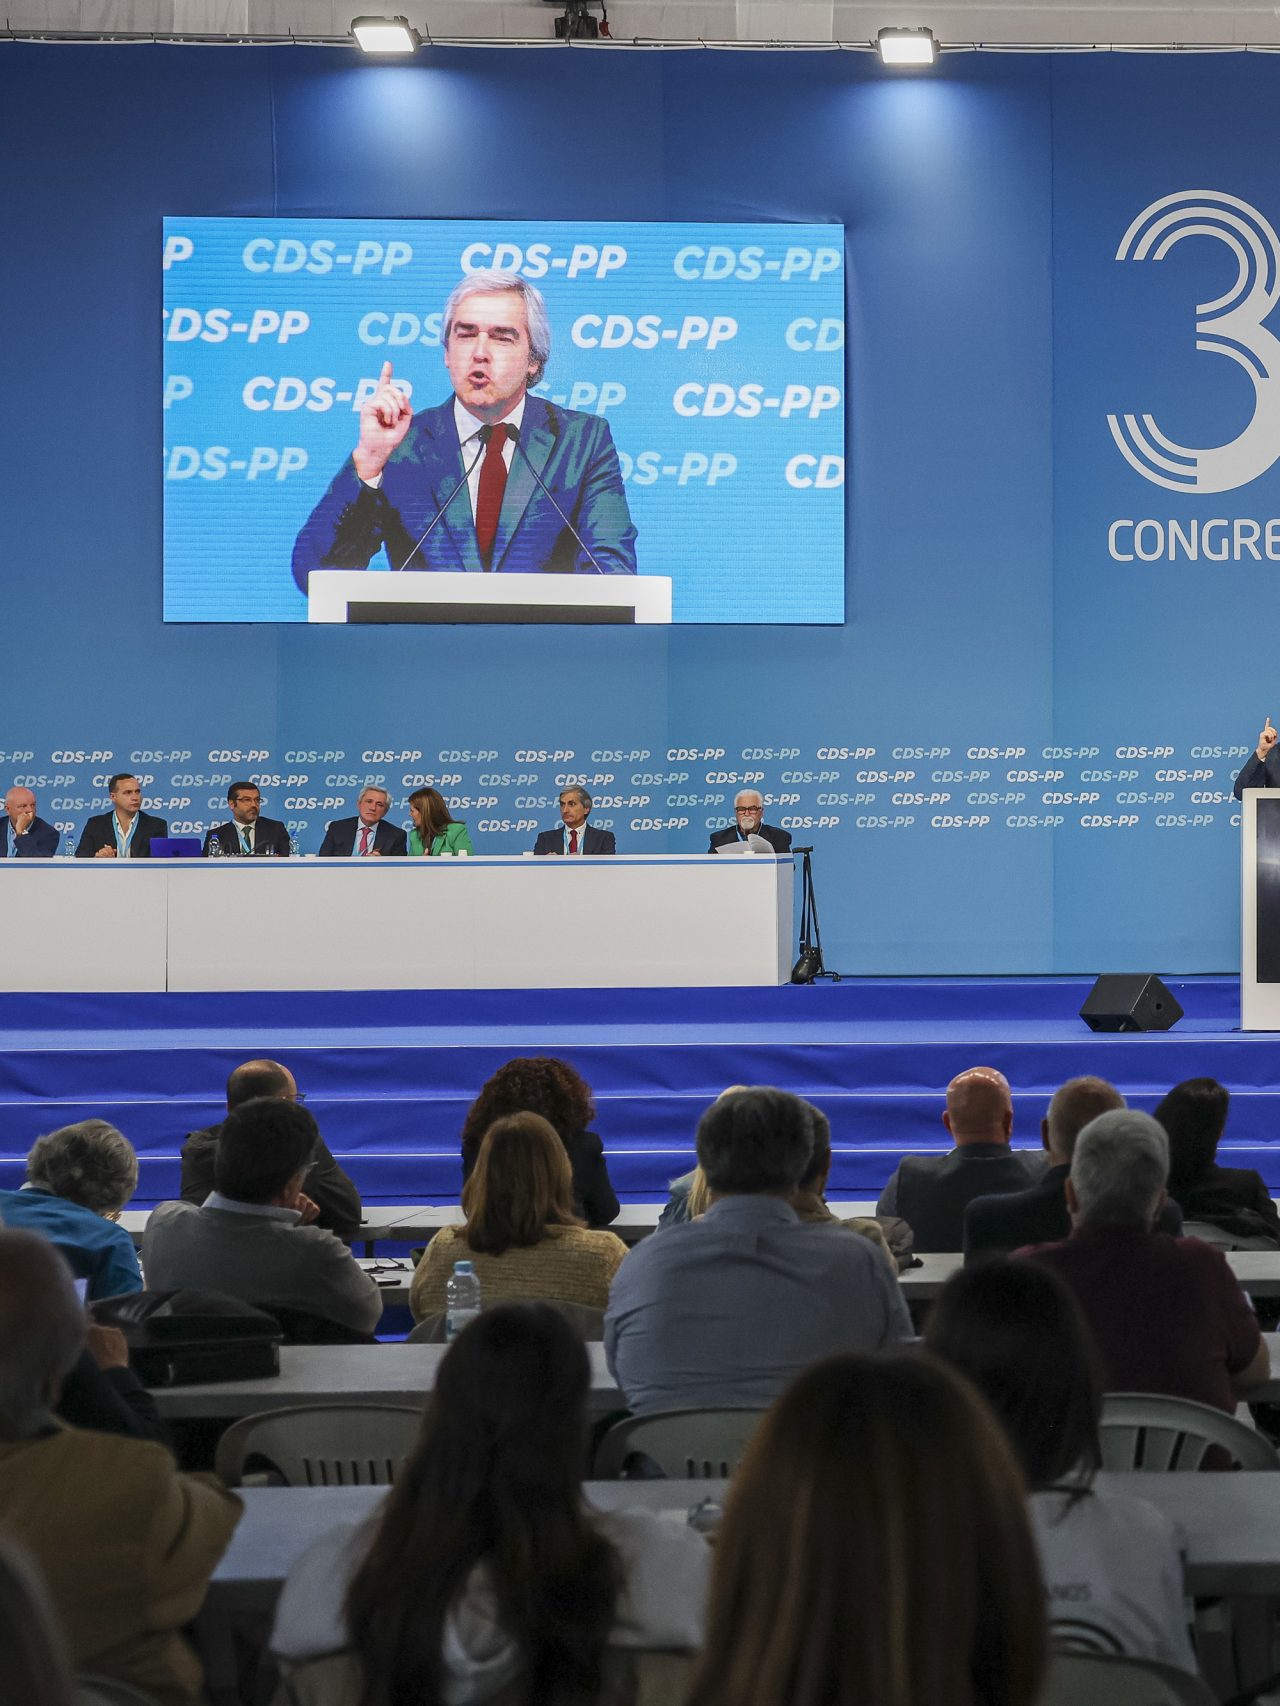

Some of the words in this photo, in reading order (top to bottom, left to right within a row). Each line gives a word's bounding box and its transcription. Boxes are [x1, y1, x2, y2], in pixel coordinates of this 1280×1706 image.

[242, 238, 413, 275] CDS-PP
[460, 243, 628, 279] CDS-PP
[673, 246, 842, 281] CDS-PP
[163, 308, 310, 344] DS-PP
[571, 314, 738, 350] CDS-PP
[672, 383, 841, 418] CDS-PP
[164, 446, 308, 481] DS-PP
[51, 751, 114, 763] CDS-PP
[130, 751, 192, 763] CDS-PP
[208, 750, 270, 762] CDS-PP
[284, 750, 346, 762] CDS-PP
[361, 750, 423, 762] CDS-PP
[438, 750, 499, 762] CDS-PP
[514, 750, 575, 762] CDS-PP
[591, 750, 651, 762] CDS-PP
[666, 748, 726, 760] CDS-PP
[741, 747, 801, 759] CDS-PP
[816, 747, 877, 759] CDS-PP
[892, 747, 952, 759] CDS-PP
[967, 747, 1027, 759] CDS-PP
[1041, 746, 1101, 758] CDS-PP
[1116, 746, 1175, 758] CDS-PP
[1190, 746, 1249, 758] CDS-PP
[13, 775, 75, 787] CDS-PP
[170, 775, 232, 787] CDS-PP
[248, 775, 309, 787] CDS-PP
[325, 774, 386, 786] CDS-PP
[401, 774, 463, 786] CDS-PP
[478, 774, 539, 786] CDS-PP
[554, 774, 615, 786] CDS-PP
[630, 773, 689, 785] CDS-PP
[705, 772, 765, 784] CDS-PP
[780, 771, 840, 783] CDS-PP
[856, 771, 916, 783] CDS-PP
[931, 770, 991, 782] CDS-PP
[1006, 770, 1065, 782] CDS-PP
[1080, 770, 1140, 782] CDS-PP
[1154, 770, 1214, 782] CDS-PP
[51, 798, 112, 810] CDS-PP
[139, 798, 192, 810] DS-PP
[284, 797, 346, 809] CDS-PP
[591, 796, 651, 808] CDS-PP
[666, 794, 726, 806] CDS-PP
[763, 793, 801, 805] S-PP
[816, 793, 876, 805] CDS-PP
[891, 793, 952, 805] CDS-PP
[966, 793, 1027, 805] CDS-PP
[1041, 792, 1101, 804] CDS-PP
[1116, 792, 1175, 804] CDS-PP
[477, 820, 538, 832] CDS-PP
[630, 818, 690, 830] CDS-PP
[780, 816, 840, 828] CDS-PP
[855, 816, 915, 828] CDS-PP
[930, 815, 991, 827] CDS-PP
[1005, 815, 1065, 827] CDS-PP
[1080, 815, 1140, 827] CDS-PP
[1154, 815, 1214, 827] CDS-PP
